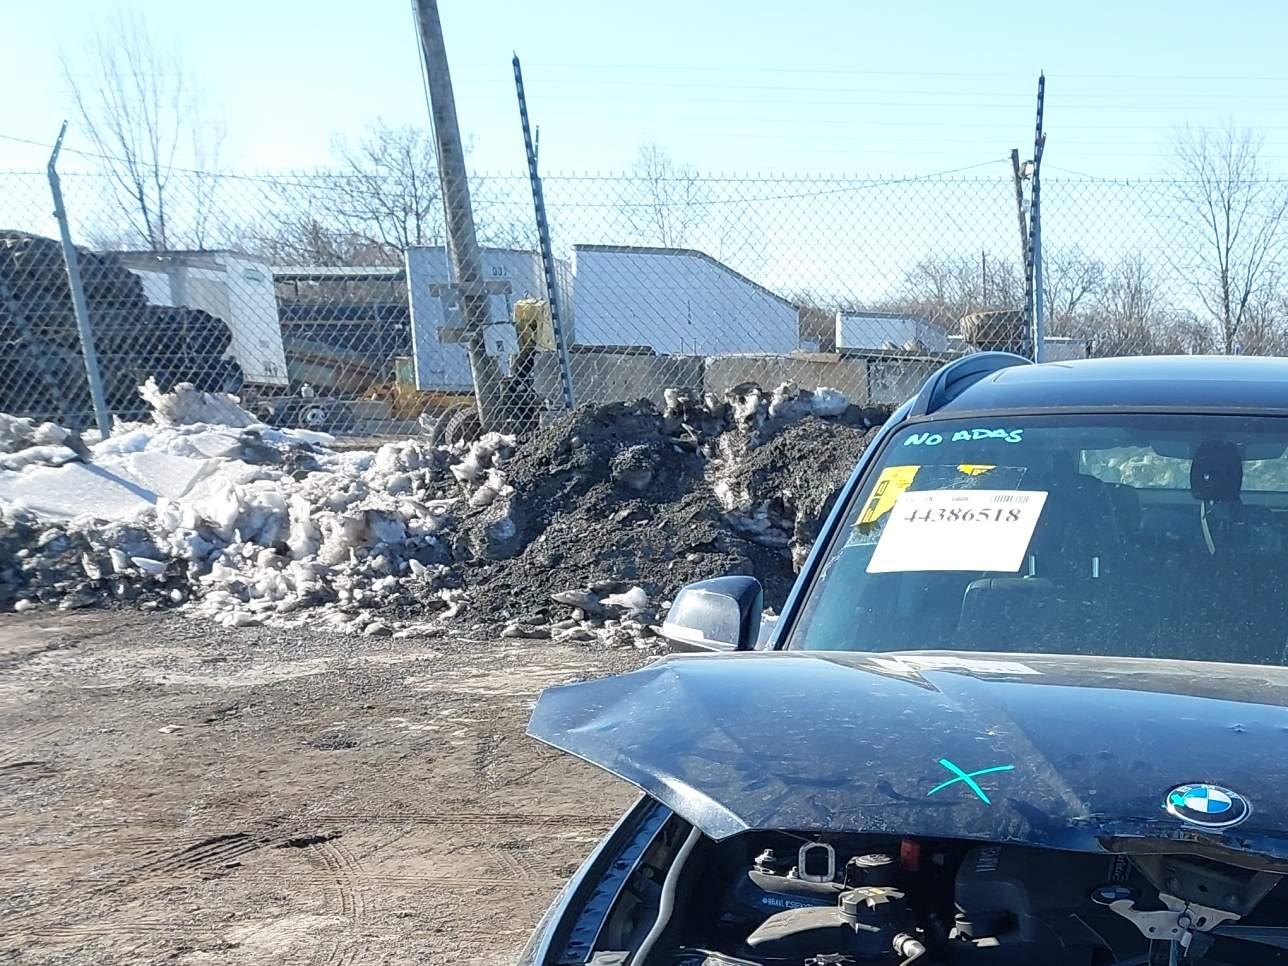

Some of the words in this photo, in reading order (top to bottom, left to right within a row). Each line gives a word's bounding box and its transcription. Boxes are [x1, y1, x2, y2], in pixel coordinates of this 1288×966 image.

[903, 433, 943, 447] NO
[951, 428, 1024, 444] ADAS
[904, 508, 1022, 523] 44386518
